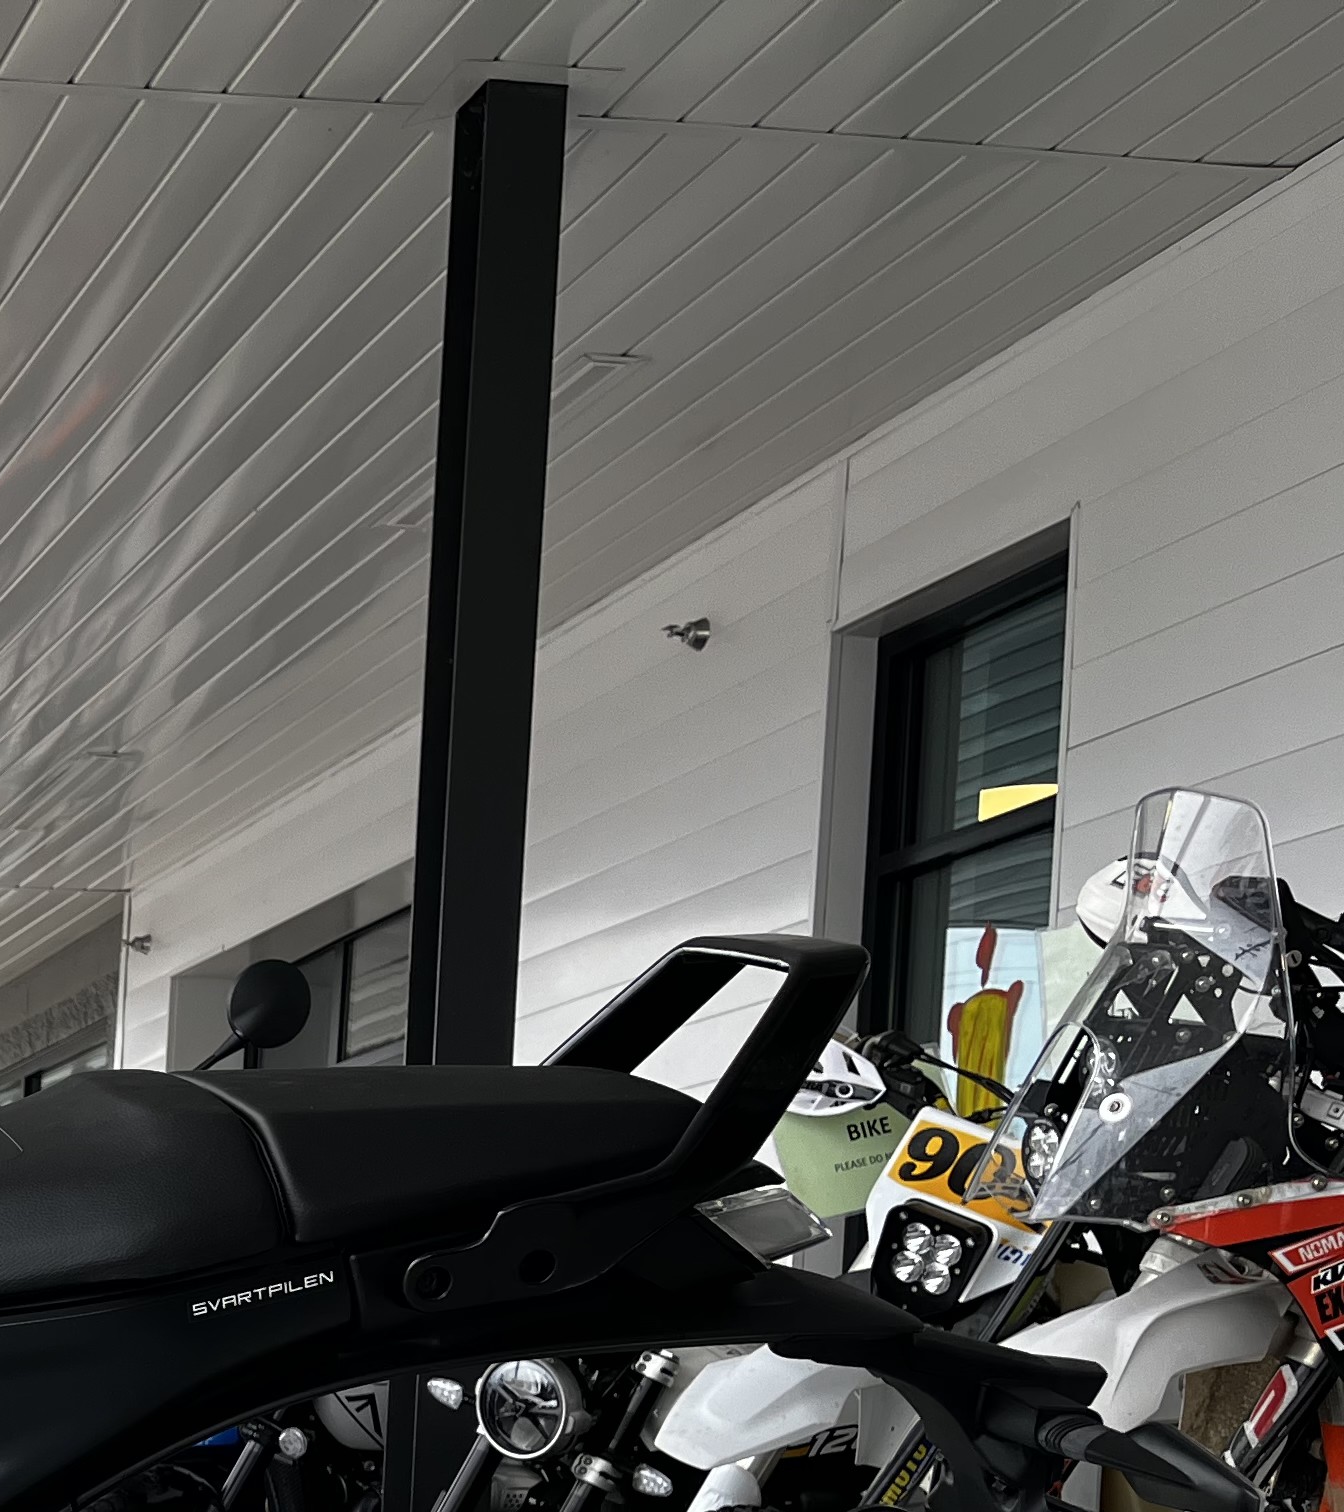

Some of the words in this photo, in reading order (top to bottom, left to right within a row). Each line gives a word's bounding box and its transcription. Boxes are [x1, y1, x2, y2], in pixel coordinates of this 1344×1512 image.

[846, 1116, 891, 1141] BIKE
[834, 1157, 868, 1172] PLEASE
[868, 1154, 883, 1165] DO
[1312, 1262, 1344, 1291] KT
[192, 1271, 334, 1316] SVARTPILEN
[808, 1426, 859, 1458] 12
